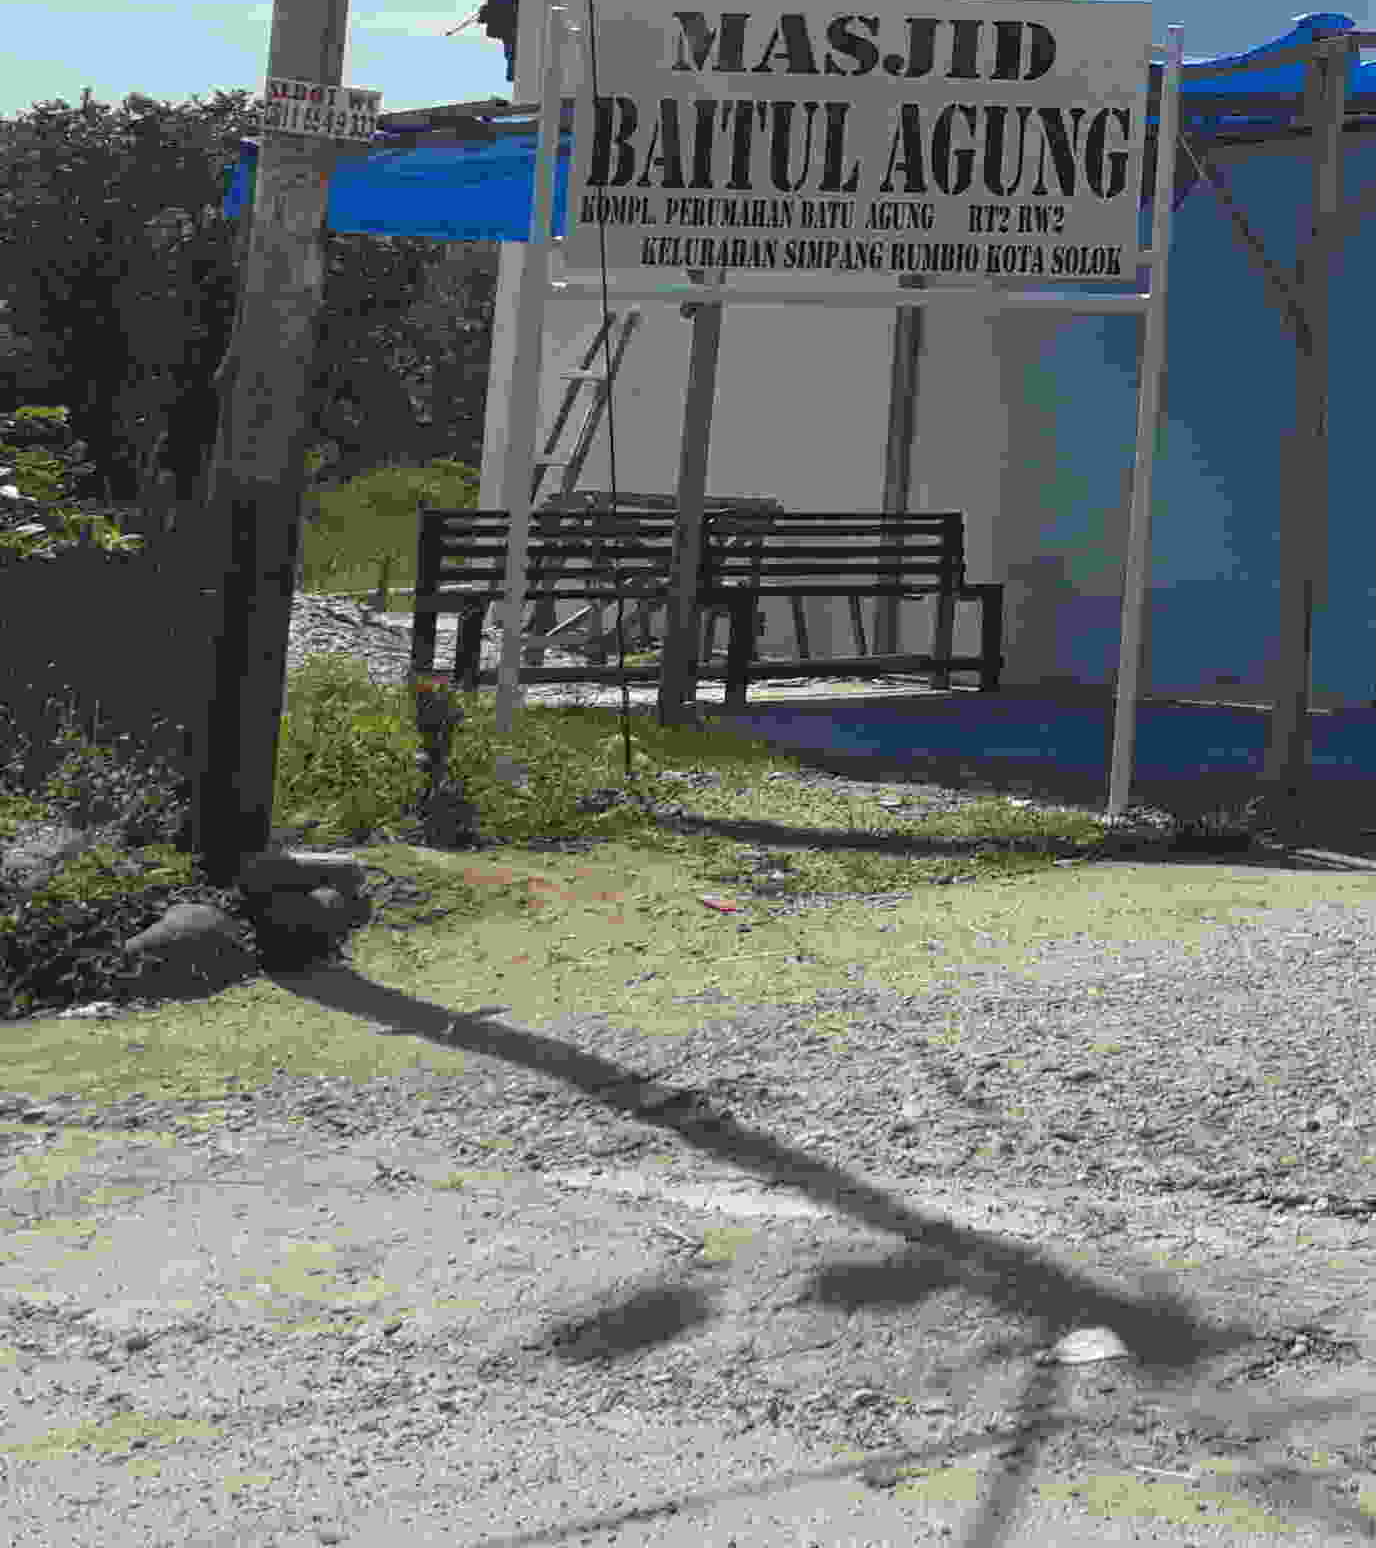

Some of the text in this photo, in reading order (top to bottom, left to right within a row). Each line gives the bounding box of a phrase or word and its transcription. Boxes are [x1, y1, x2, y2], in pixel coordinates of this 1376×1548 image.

[672, 11, 1057, 80] MASJID
[585, 96, 1131, 198] BAITUL AGUNG
[579, 195, 1065, 233] KOMPL. PERUMAHAN BATU AGUNG RT2 RW2
[640, 236, 1121, 275] KELURAHAN SIMPANG RUMBIO KOTA SOLOK
